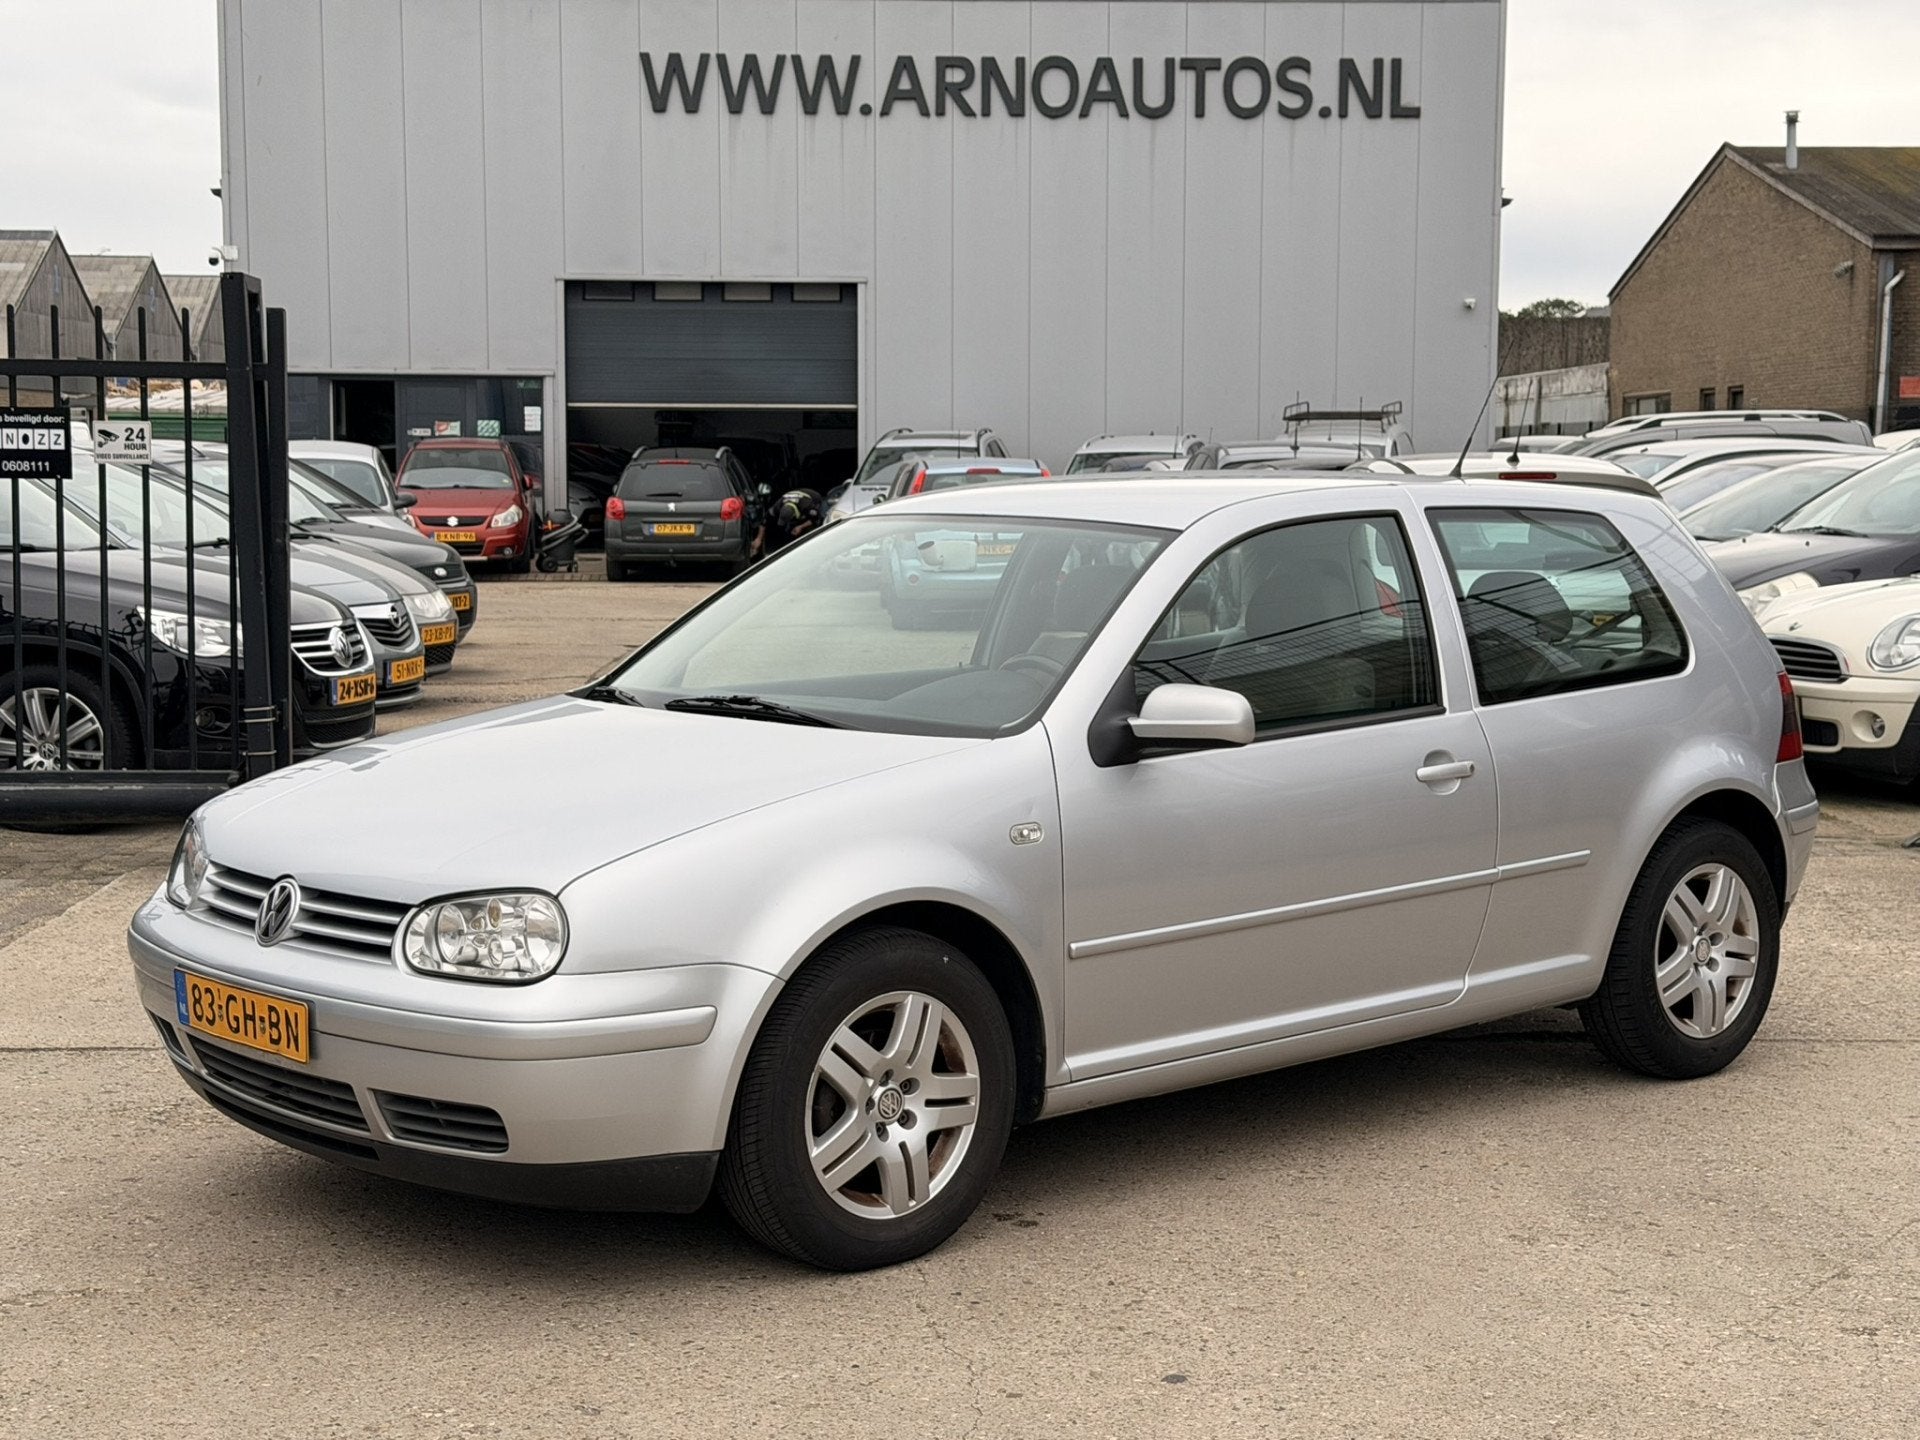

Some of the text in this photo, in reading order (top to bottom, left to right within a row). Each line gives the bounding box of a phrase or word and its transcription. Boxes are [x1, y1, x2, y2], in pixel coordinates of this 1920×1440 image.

[640, 52, 1421, 119] WWW.ARNOAUTOS.NL
[124, 427, 146, 442] 24
[124, 442, 147, 451] HOUR
[2, 460, 50, 472] 0608111
[191, 982, 299, 1053] 83-GH-BN
